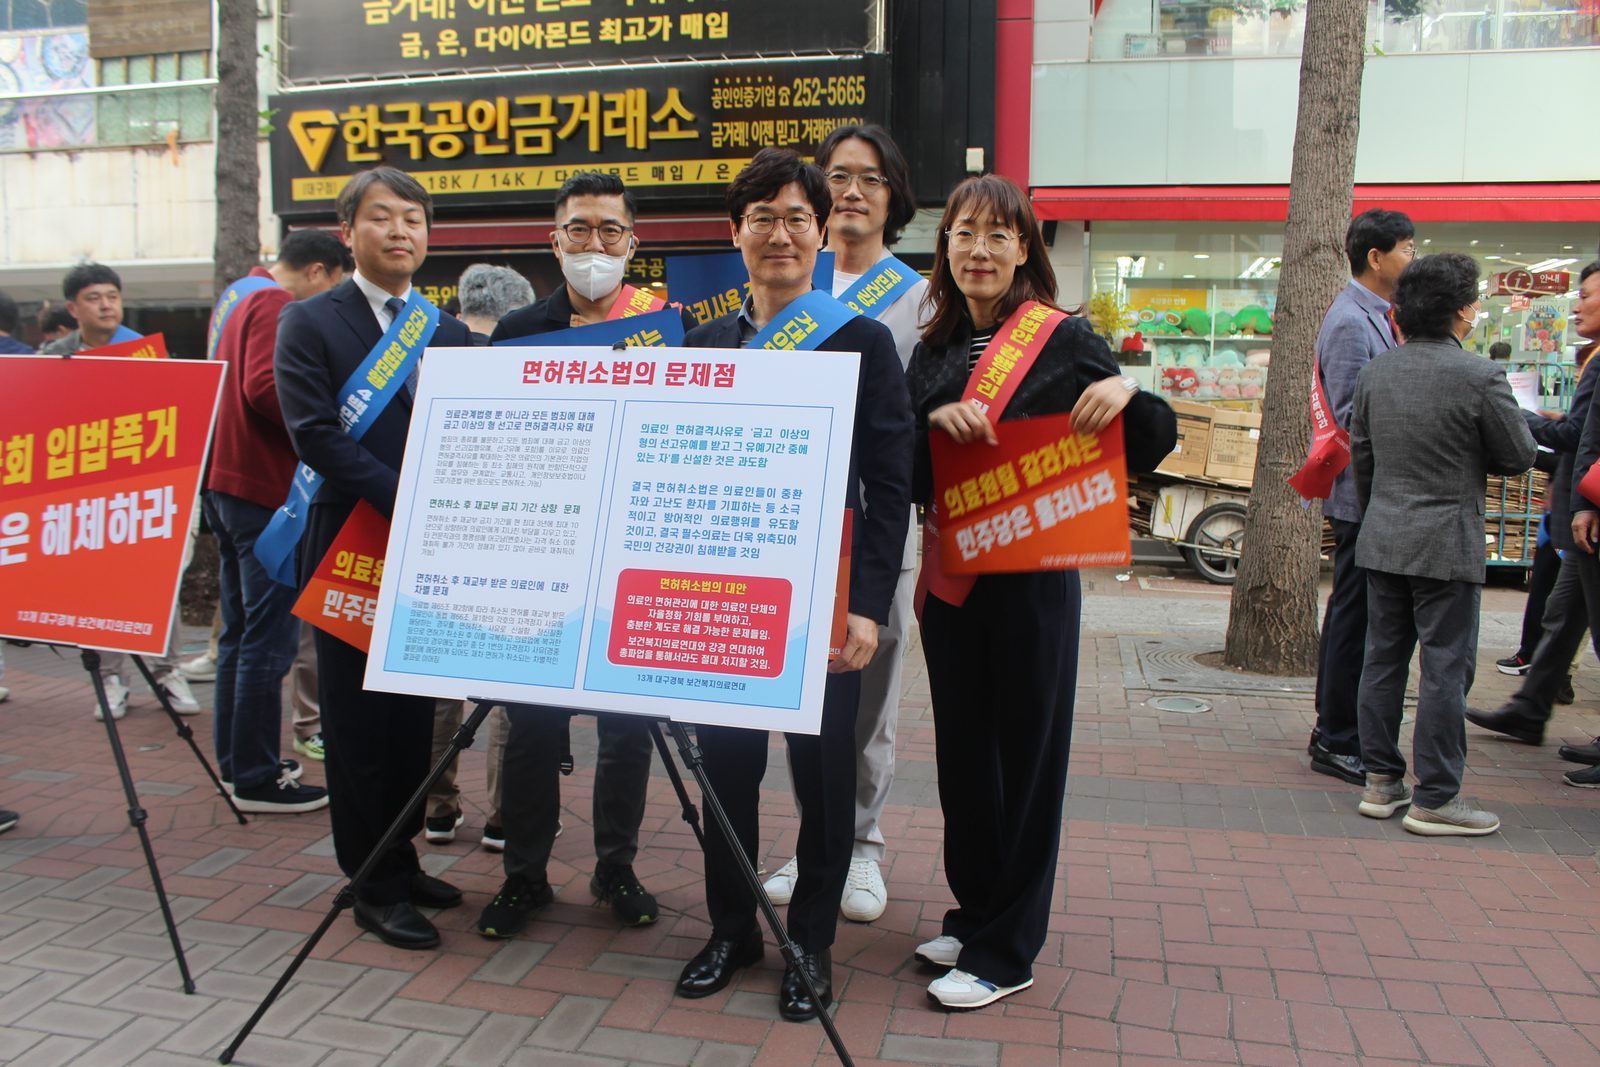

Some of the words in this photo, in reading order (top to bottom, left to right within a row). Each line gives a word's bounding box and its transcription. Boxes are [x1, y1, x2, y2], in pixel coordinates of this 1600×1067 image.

[400, 32, 430, 60] 금,
[437, 29, 468, 57] 은,
[474, 20, 592, 52] 다이아몬드
[599, 15, 673, 44] 최고가
[680, 11, 729, 40] 매입
[711, 85, 776, 110] 공인인증기업
[793, 75, 866, 108] 252-5665
[338, 88, 700, 162] 한국공인금거래소
[711, 121, 749, 148] 금거래!
[751, 119, 775, 147] 이젠
[776, 118, 800, 146] 믿고
[428, 175, 462, 190] 18K
[491, 172, 525, 188] 14K
[651, 164, 683, 182] 매입
[523, 360, 655, 385] 면허취소법의
[665, 362, 735, 388] 문제점
[446, 409, 493, 420] 의료관계법령
[505, 410, 530, 420] 아니라
[531, 410, 548, 421] 모든
[550, 411, 576, 421] 범죄에
[578, 411, 596, 422] 대해
[443, 420, 460, 430] 금고
[461, 420, 486, 430] 이상의
[497, 421, 522, 431] 선고로
[524, 421, 574, 432] 면허결격사유
[576, 422, 594, 432] 확대
[640, 423, 669, 435] 의료인
[676, 424, 743, 437] 면허결격사유로
[780, 428, 810, 440] 이상의
[0, 433, 35, 486] 회
[47, 406, 178, 481] 입법폭거
[639, 437, 658, 449] 형의
[660, 438, 708, 451] 선고유예를
[711, 440, 730, 452] 받고
[732, 441, 743, 452] 그
[745, 442, 786, 454] 유예기간
[788, 443, 808, 455] 중에
[636, 452, 655, 463] 있는
[683, 454, 713, 466] 신설한
[715, 455, 735, 467] 것은
[738, 456, 768, 468] 과도함
[632, 481, 652, 492] 결국
[656, 482, 718, 496] 면허취소법은
[723, 485, 776, 498] 의료인들이
[781, 488, 803, 500] 중환
[429, 498, 460, 509] 면허취소
[463, 500, 472, 510] 후
[474, 500, 499, 511] 재교부
[501, 501, 518, 512] 금지
[520, 502, 538, 513] 기간
[563, 504, 581, 515] 문제
[630, 495, 650, 507] 자와
[653, 497, 683, 509] 고난도
[686, 498, 717, 511] 환자를
[721, 500, 761, 513] 기피하는
[765, 502, 776, 514] 등
[779, 503, 800, 515] 소극
[41, 485, 178, 557] 해체하라
[628, 510, 656, 522] 적이고
[664, 512, 703, 525] 방어적인
[710, 515, 760, 528] 의료행위를
[769, 518, 799, 531] 유도할
[626, 525, 657, 538] 것이고,
[660, 527, 679, 539] 결국
[682, 528, 731, 542] 필수의료는
[733, 531, 754, 543] 더욱
[757, 533, 797, 545] 위축되어
[955, 502, 1034, 562] 민주당은
[624, 540, 652, 552] 국민의
[655, 542, 694, 555] 건강권이
[697, 544, 737, 558] 침해받을
[740, 547, 760, 559] 것임
[414, 584, 431, 595] 차별
[432, 585, 449, 596] 문제
[416, 573, 448, 585] 면허취소
[451, 575, 460, 585] 후
[463, 576, 488, 587] 재교부
[490, 578, 508, 589] 받은
[510, 579, 545, 591] 의료인에
[551, 582, 569, 593] 대한
[660, 578, 722, 593] 면허취소법의
[725, 582, 747, 595] 대안
[627, 595, 653, 606] 의료인
[655, 597, 698, 609] 면허관리에
[700, 600, 719, 611] 대한
[721, 601, 748, 613] 의료인
[750, 603, 777, 615] 단체의
[648, 608, 682, 620] 자율정화
[685, 611, 711, 623] 기회를
[713, 613, 752, 626] 부여하고,
[626, 619, 653, 631] 충분한
[654, 621, 681, 633] 계도로
[683, 623, 701, 635] 해결
[703, 625, 730, 637] 가능한
[628, 636, 706, 651] 보건복지의료연대와
[708, 642, 726, 654] 강경
[729, 644, 765, 656] 연대하여
[619, 648, 653, 660] 총파업을
[655, 650, 699, 664] 통해서라도
[701, 654, 719, 665] 절대
[721, 656, 748, 668] 저지할
[750, 658, 772, 670] 것임.
[637, 674, 654, 683] 13개
[655, 675, 685, 686] 대구경북
[686, 678, 746, 691] 보건복지의료연대
